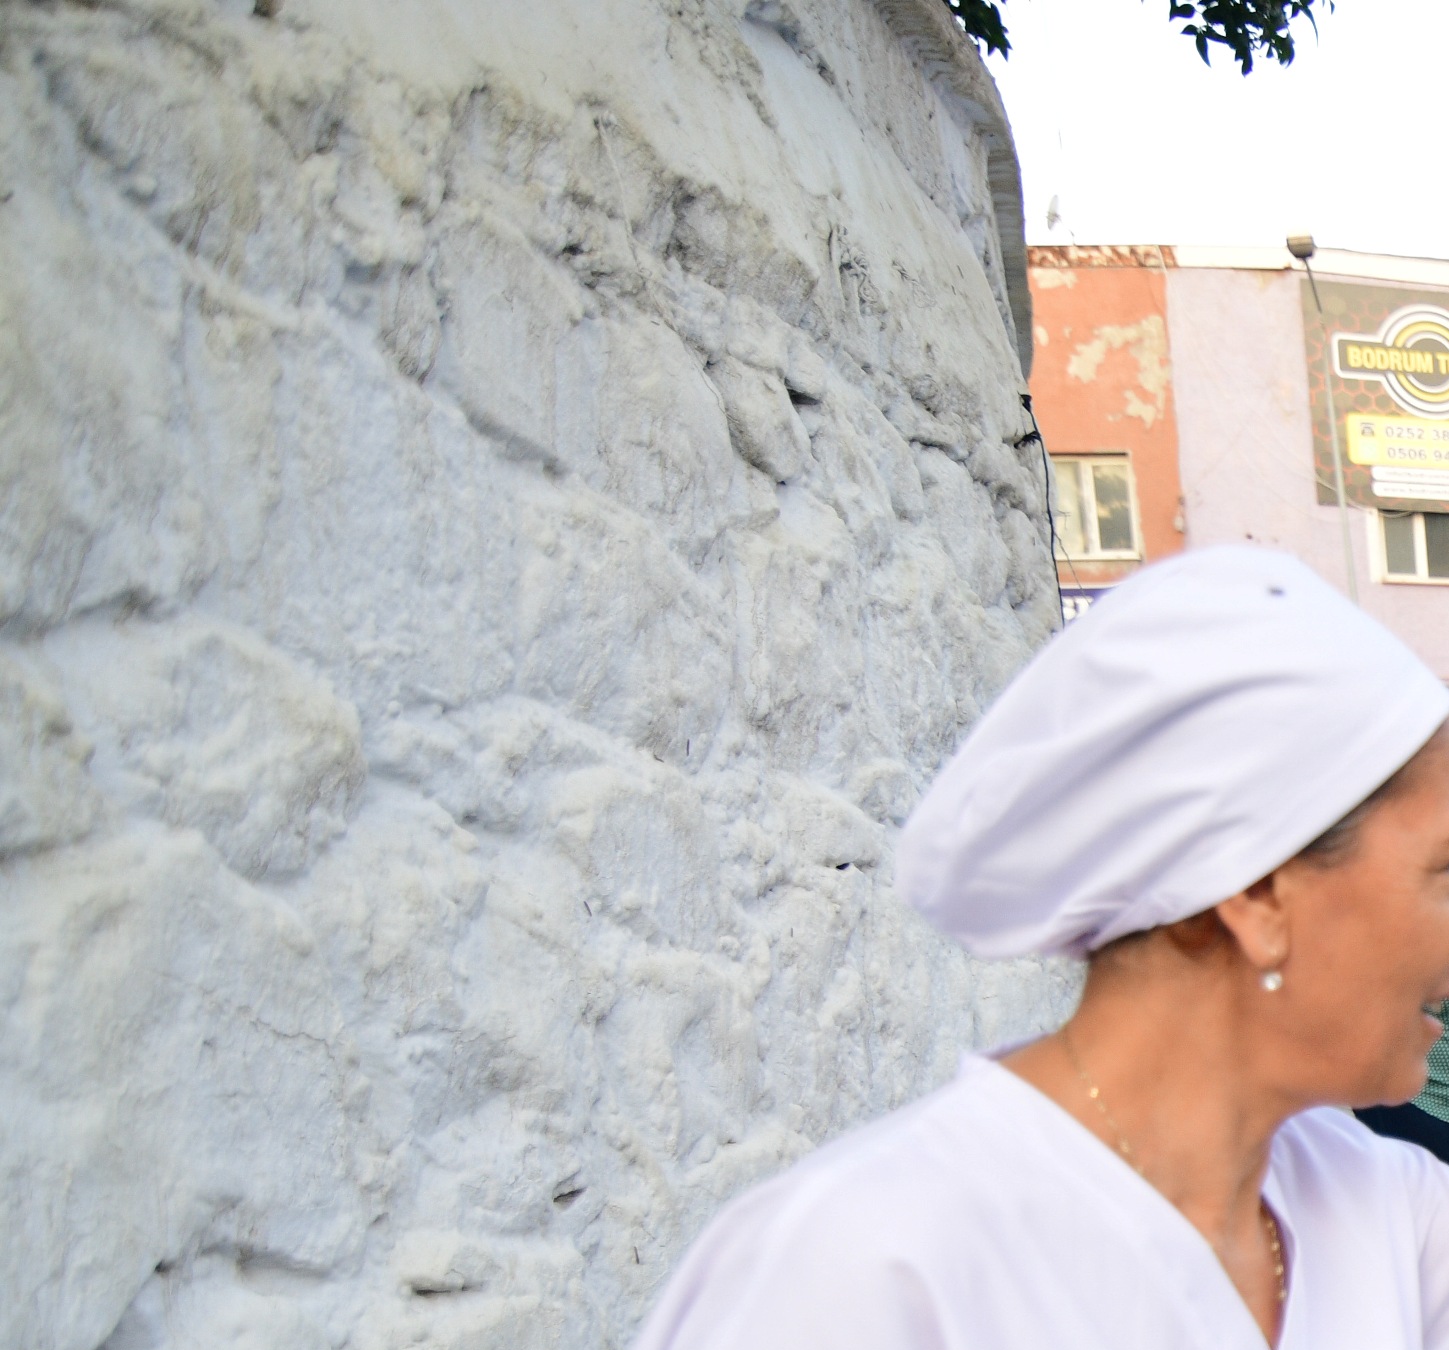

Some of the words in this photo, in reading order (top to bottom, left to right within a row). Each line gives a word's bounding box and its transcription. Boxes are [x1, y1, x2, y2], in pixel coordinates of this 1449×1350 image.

[1346, 345, 1434, 374] BODRUM
[1385, 425, 1425, 440] 0252
[1387, 446, 1427, 461] 0506
